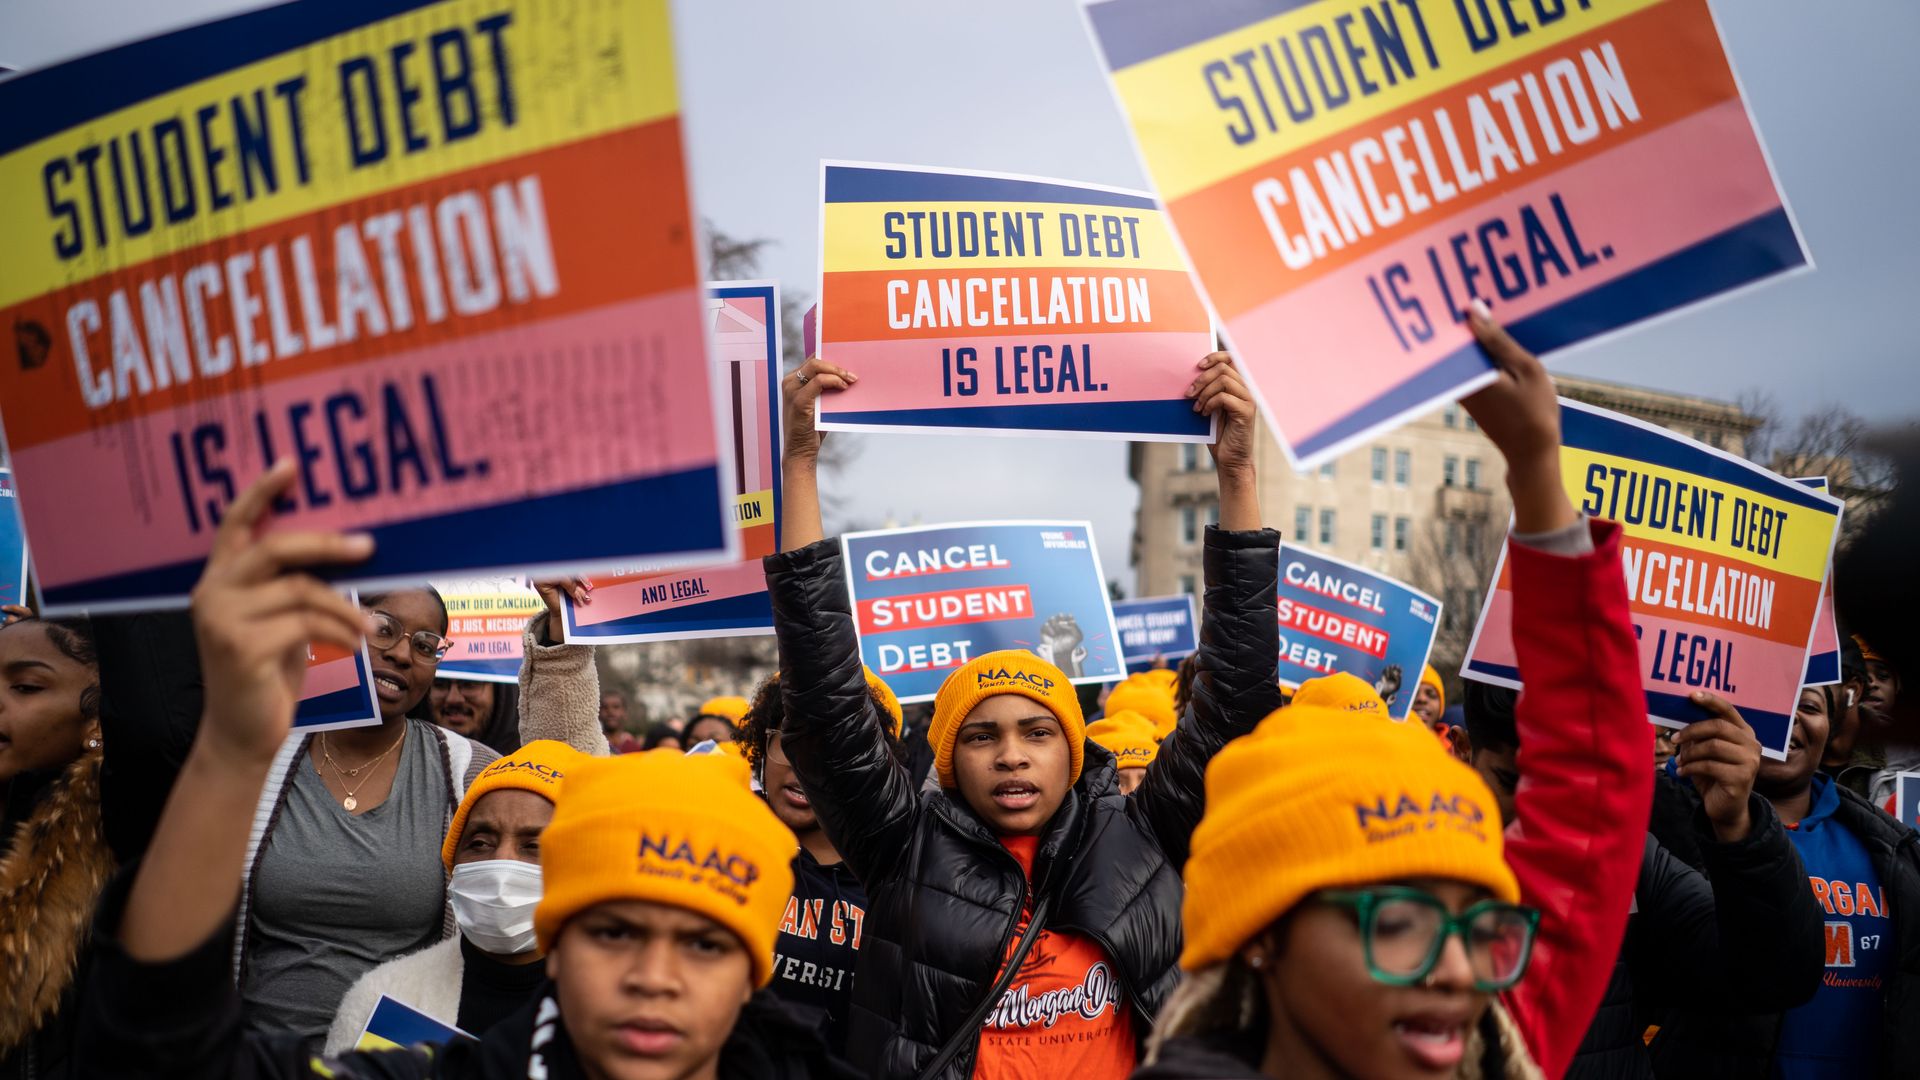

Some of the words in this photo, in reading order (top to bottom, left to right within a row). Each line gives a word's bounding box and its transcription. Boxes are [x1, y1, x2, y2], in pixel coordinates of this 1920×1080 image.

[1201, 0, 1440, 146] STUDENT
[42, 76, 311, 261] STUDENT
[339, 13, 519, 169] DEBT
[1252, 41, 1642, 271] CANCELLATION
[884, 211, 1044, 259] STUDENT
[1059, 212, 1140, 259] DEBT
[66, 174, 560, 409] CANCELLATION
[1367, 262, 1434, 351] IS
[1426, 192, 1616, 324] LEGAL.
[887, 277, 1152, 329] CANCELLATION
[942, 347, 978, 397] IS
[995, 344, 1108, 395] LEGAL.
[171, 422, 234, 535] IS
[255, 373, 491, 516] LEGAL.
[1582, 463, 1724, 541] STUDENT
[1731, 500, 1788, 560] DEBT
[865, 544, 1009, 578] CANCEL
[1286, 562, 1385, 612] CANCEL
[641, 584, 667, 605] AND
[670, 578, 710, 602] LEGAL.
[871, 589, 1026, 627] STUDENT
[1622, 546, 1776, 630] NCELLATION
[468, 642, 485, 654] AND
[1278, 599, 1386, 653] STUDENT
[878, 640, 972, 673] DEBT
[977, 668, 1055, 690] NAACP
[1651, 628, 1736, 693] LEGAL.
[978, 679, 1005, 690] Youth
[1021, 681, 1051, 697] College
[1112, 747, 1151, 757] AACP
[638, 832, 760, 888] NAACP
[778, 895, 824, 941] AN
[830, 899, 865, 951] ST
[1809, 876, 1890, 919] RGA
[1860, 935, 1881, 950] 67
[989, 1036, 1031, 1046] STATE
